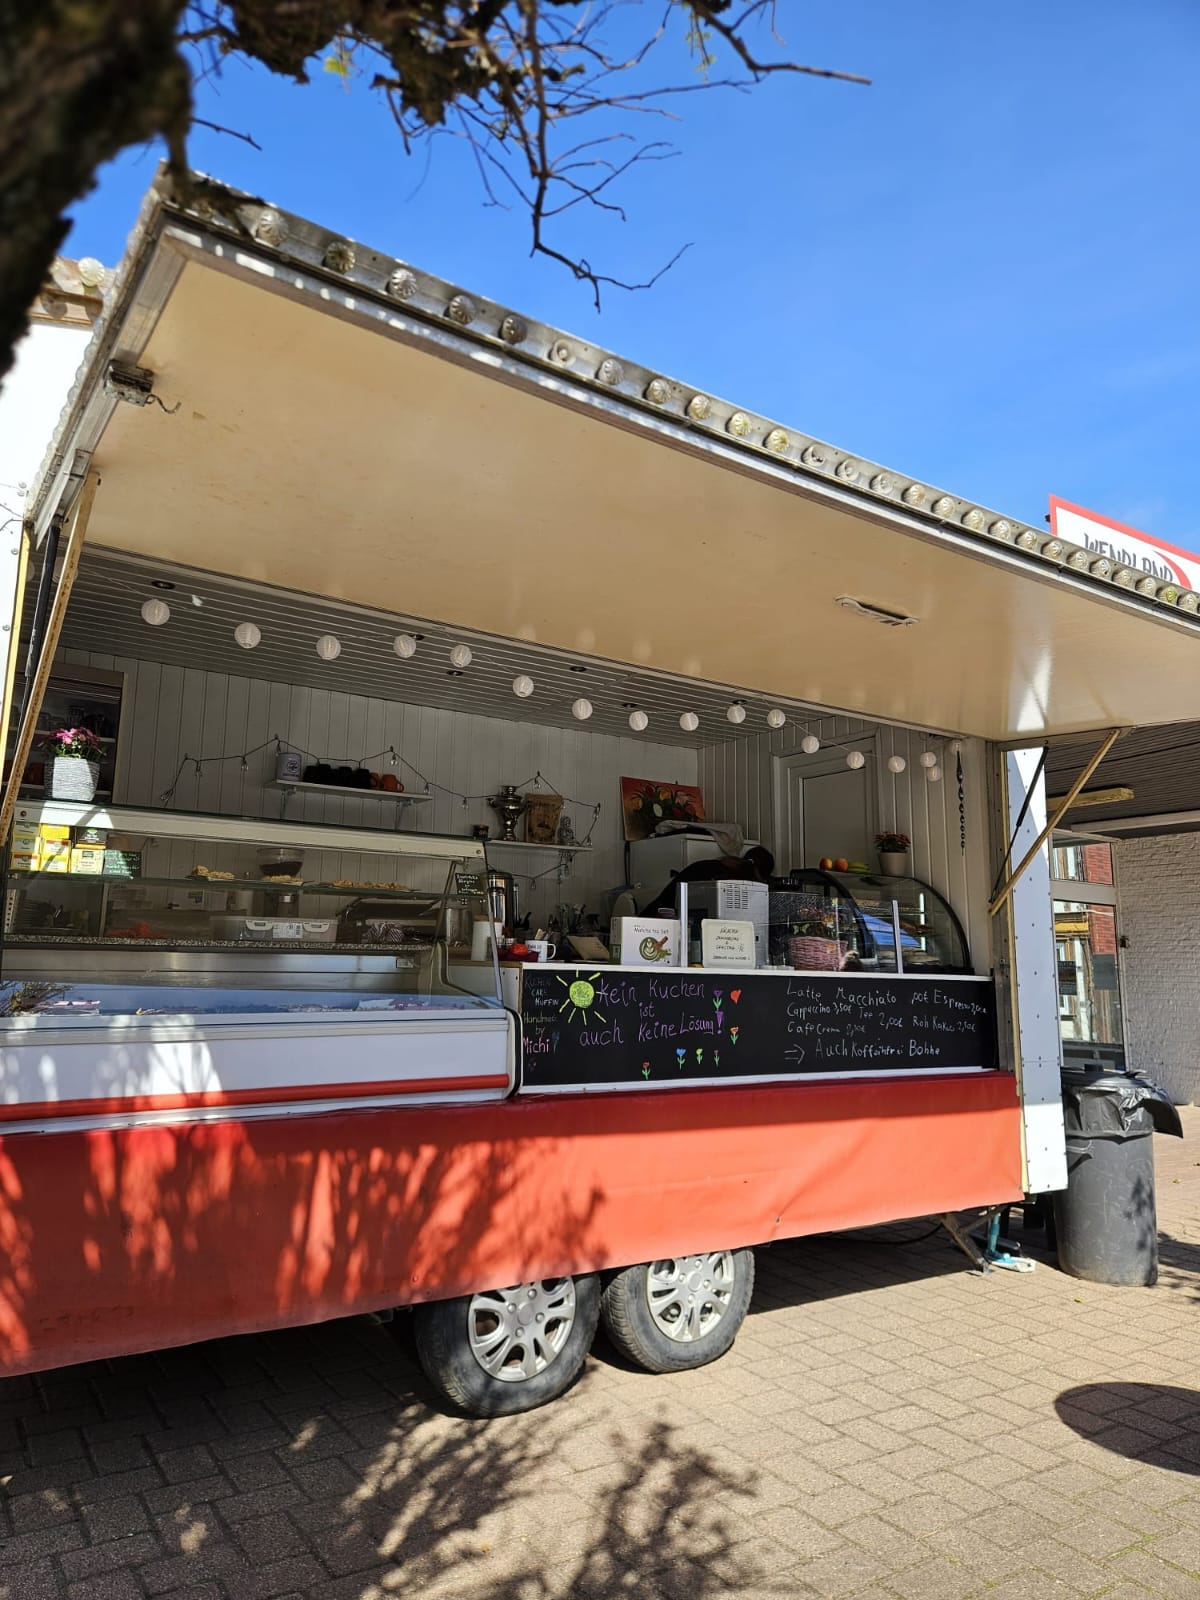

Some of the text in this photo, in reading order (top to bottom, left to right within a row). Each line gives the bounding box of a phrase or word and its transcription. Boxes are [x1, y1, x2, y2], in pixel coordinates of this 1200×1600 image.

[836, 986, 897, 1007] Macchiato
[639, 1001, 655, 1018] ist
[579, 1019, 624, 1047] auch
